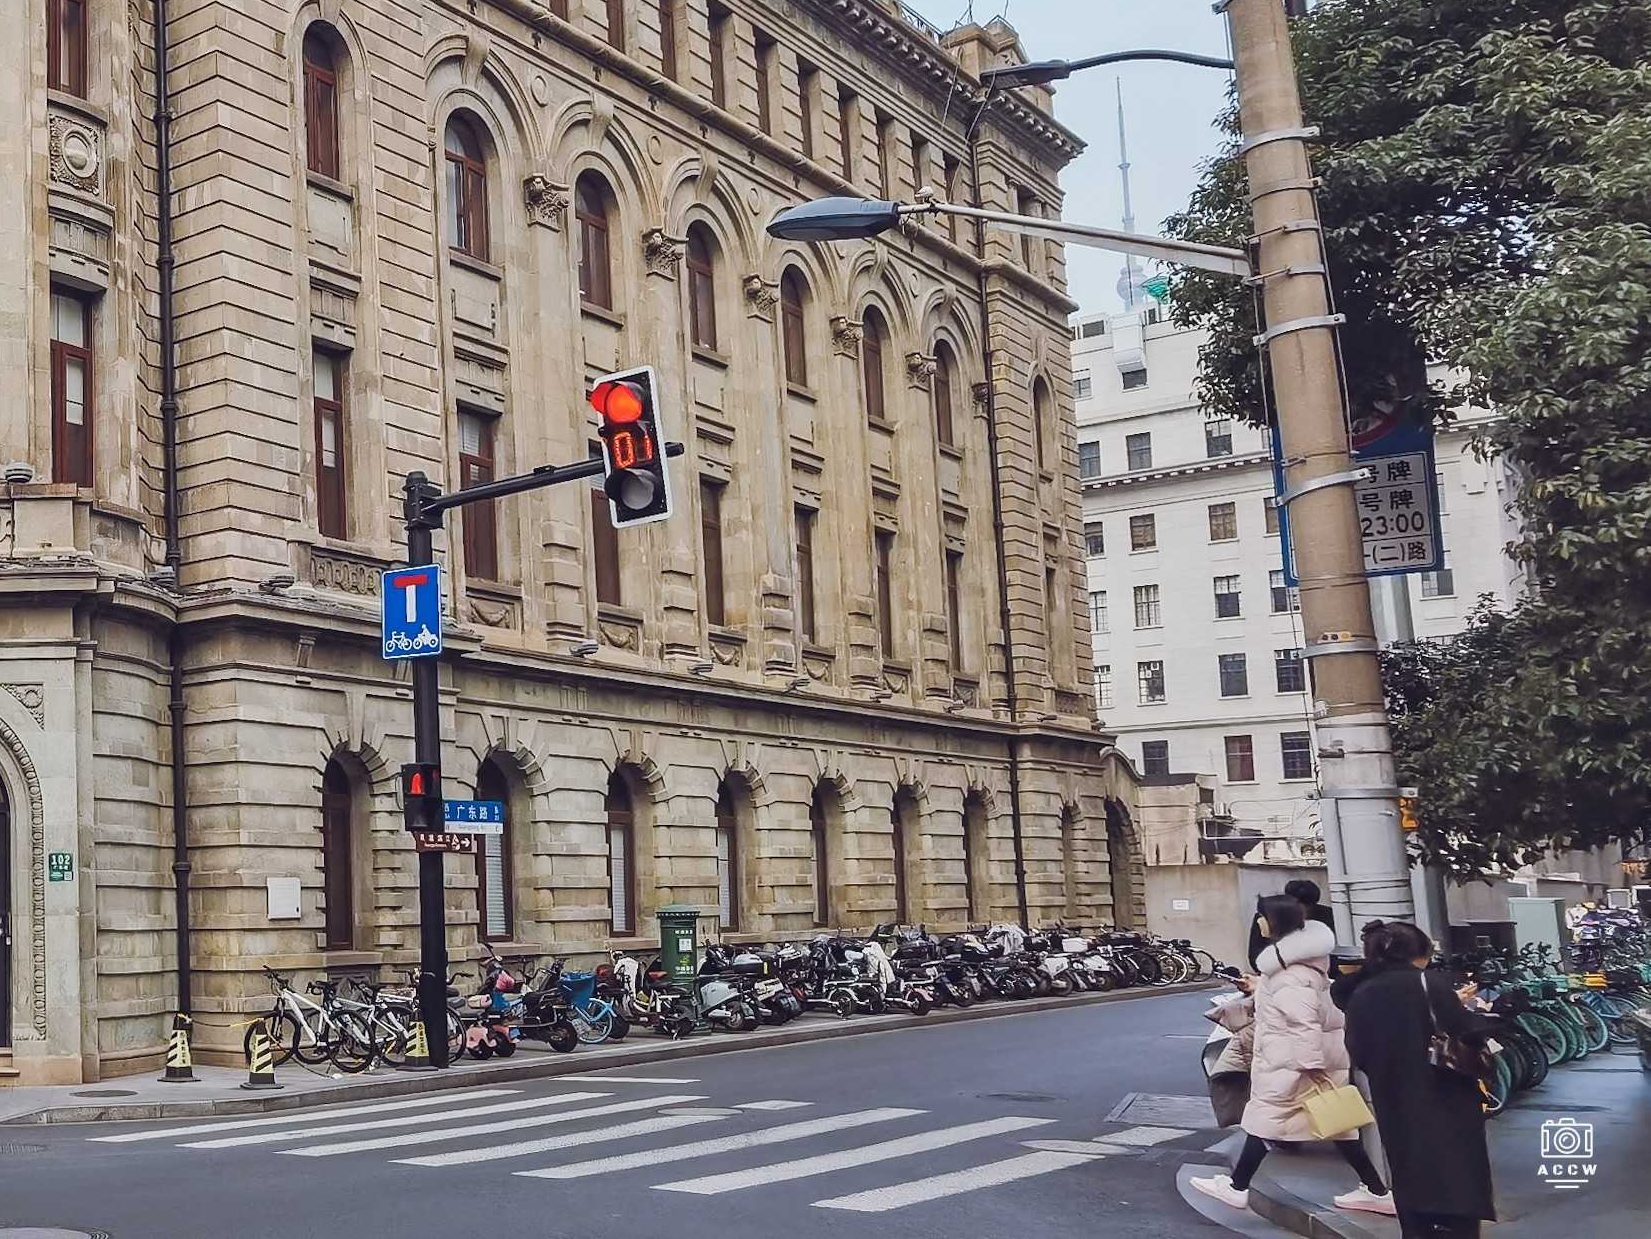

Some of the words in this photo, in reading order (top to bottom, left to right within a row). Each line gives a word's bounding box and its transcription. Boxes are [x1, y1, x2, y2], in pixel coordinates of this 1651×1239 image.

[1359, 490, 1415, 513] 号牌
[1361, 511, 1425, 538] 23:00
[51, 854, 71, 866] 102
